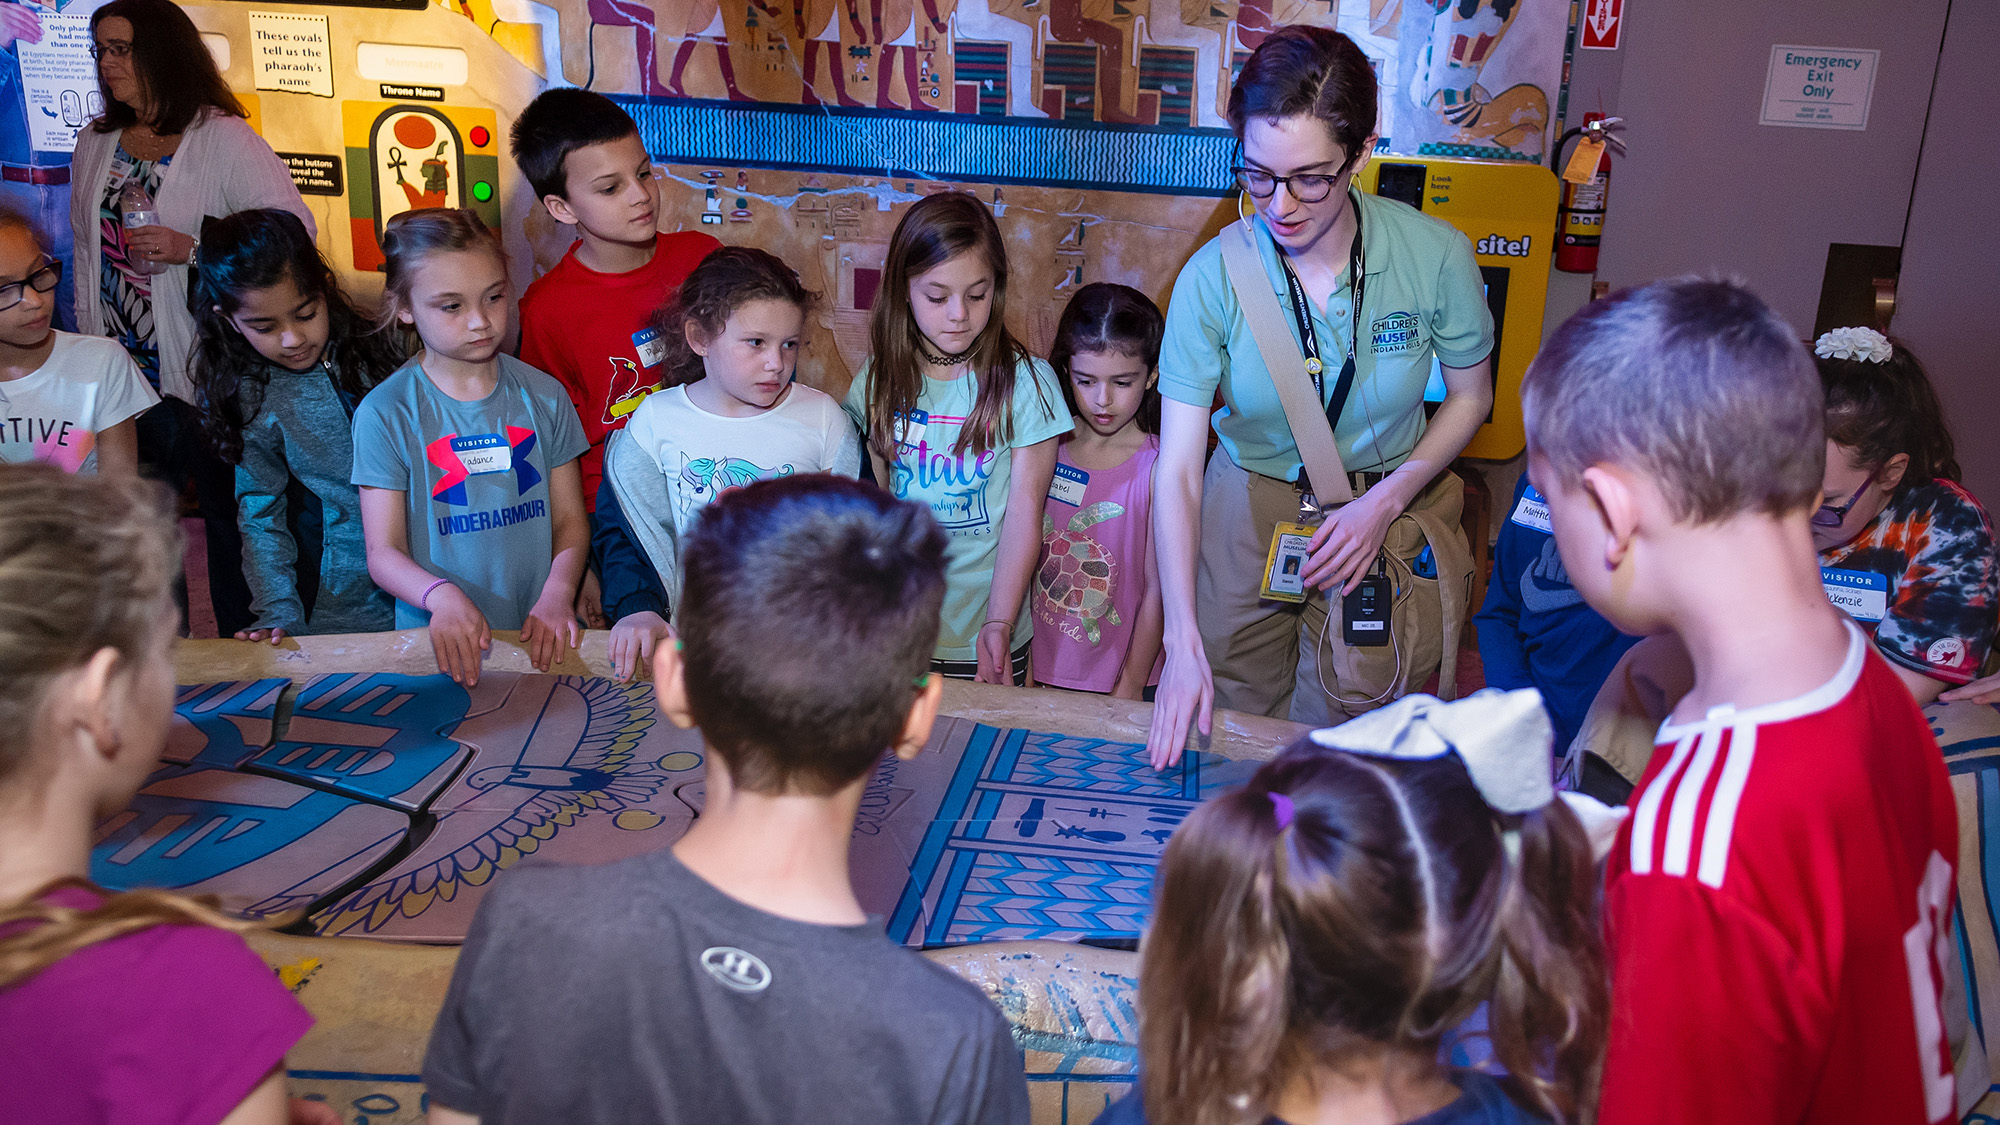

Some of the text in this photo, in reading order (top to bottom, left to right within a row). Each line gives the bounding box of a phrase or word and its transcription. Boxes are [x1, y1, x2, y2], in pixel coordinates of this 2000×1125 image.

[50, 24, 66, 32] Only
[256, 30, 322, 42] These ovals
[263, 46, 282, 55] tell
[302, 48, 321, 57] the
[265, 60, 322, 72] pharaoh's
[1785, 53, 1862, 71] Emergency
[279, 78, 311, 86] name
[1807, 69, 1834, 82] Exit
[382, 85, 441, 98] Throne Name
[1803, 84, 1835, 100] Only
[291, 158, 304, 167] the
[304, 158, 333, 169] buttons
[312, 168, 325, 177] the
[308, 179, 335, 188] names.
[1477, 233, 1531, 257] site!
[1371, 328, 1419, 345] MUSEUM
[0, 418, 73, 447] TIVE
[457, 438, 498, 448] VISITOR
[1056, 466, 1082, 479] ISITOR
[1523, 505, 1550, 521] Matthe
[1823, 572, 1872, 585] VISITOR
